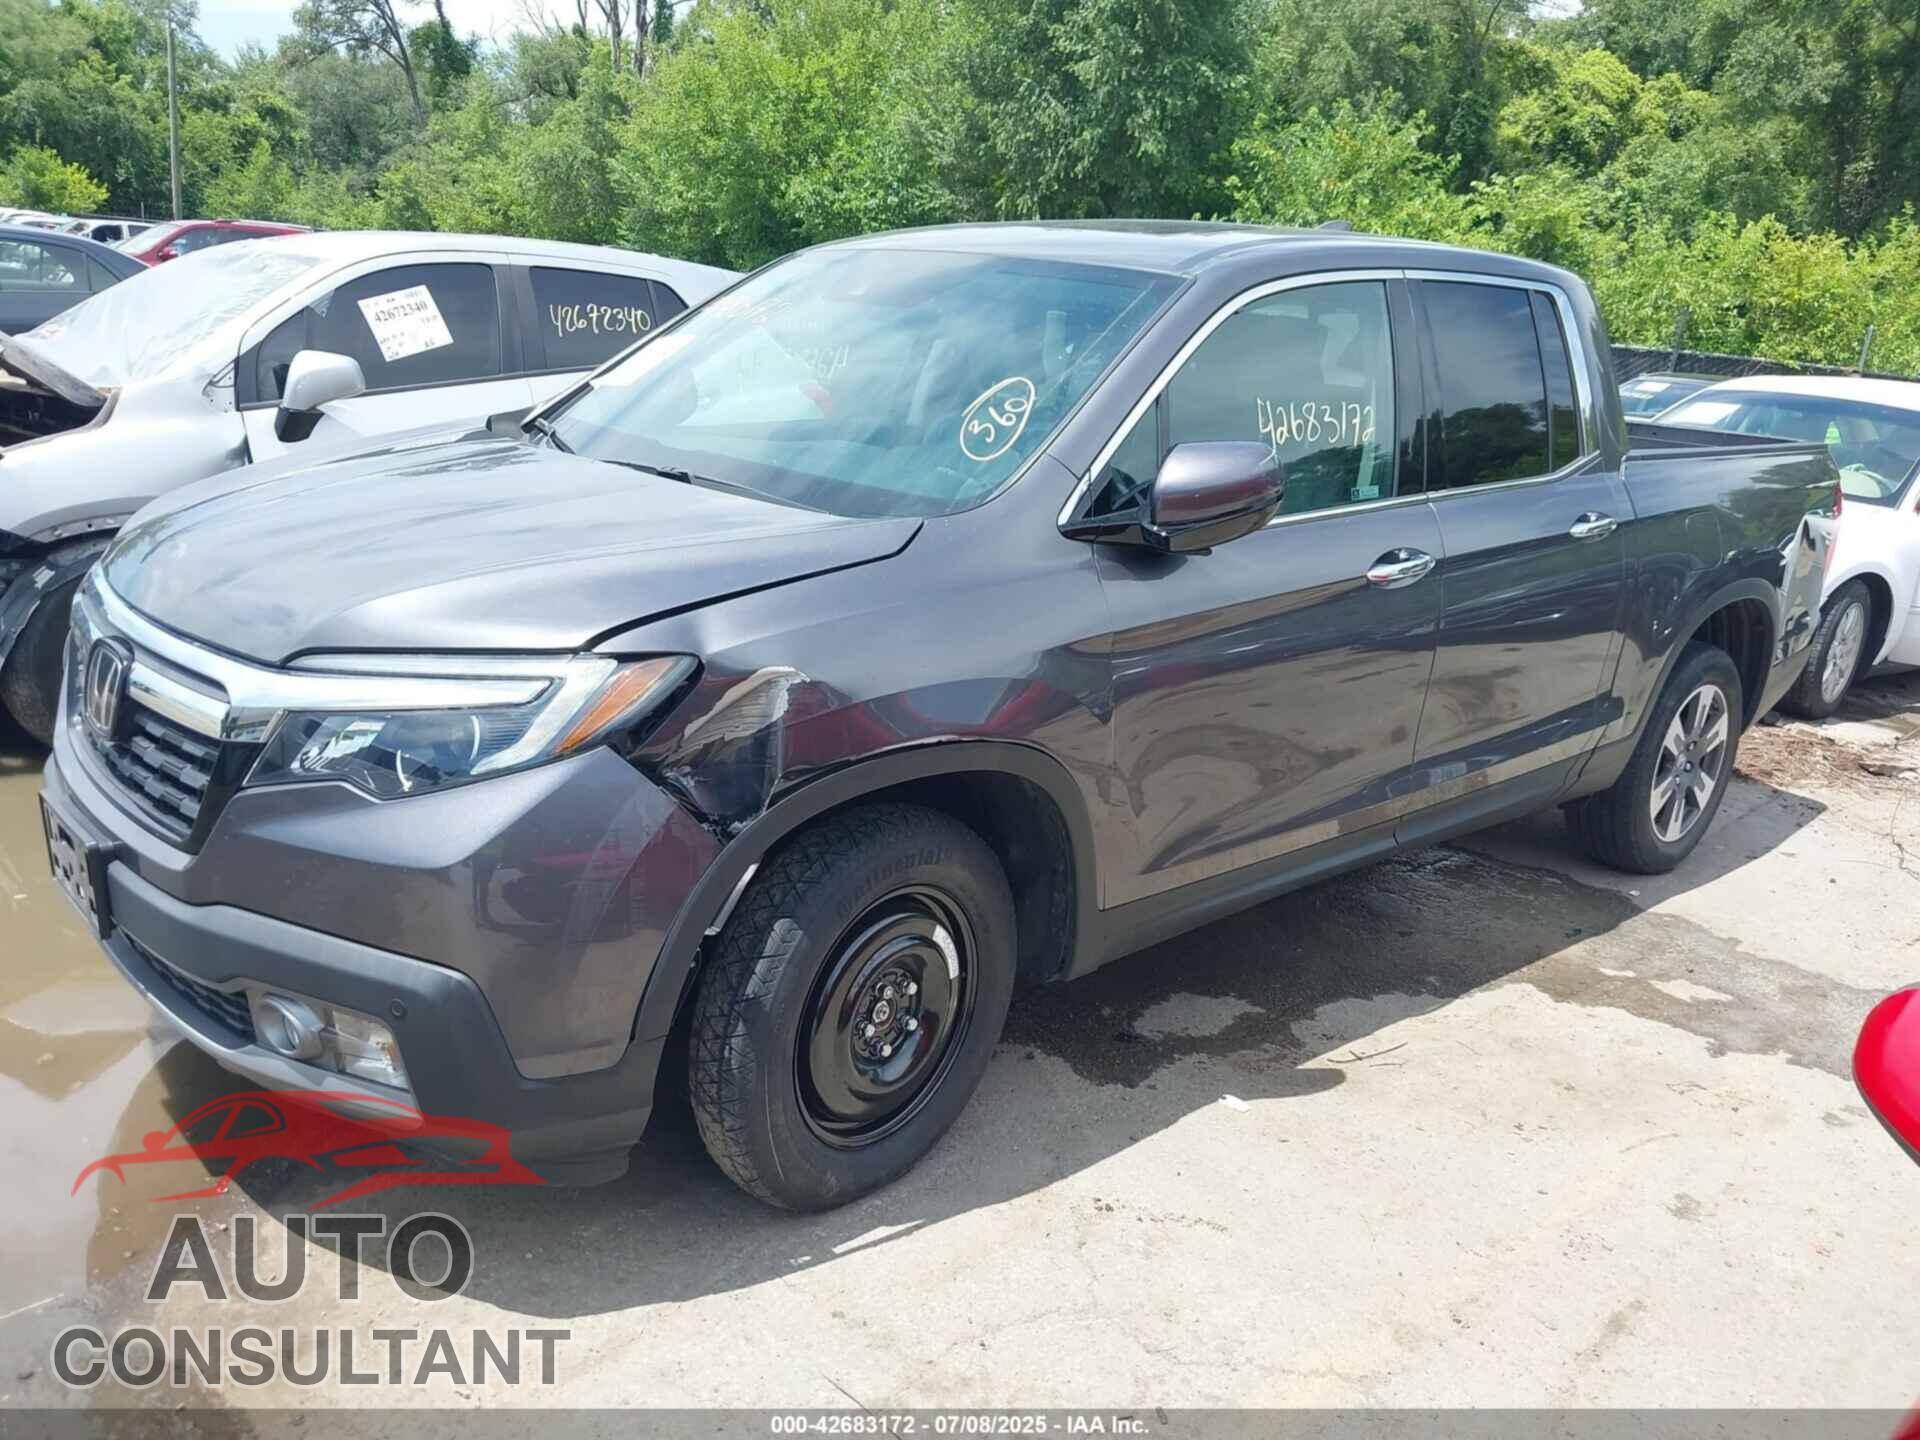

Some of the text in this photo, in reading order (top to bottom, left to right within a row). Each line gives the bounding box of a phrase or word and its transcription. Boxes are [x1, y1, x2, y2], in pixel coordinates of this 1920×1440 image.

[549, 302, 651, 338] 42672340
[967, 396, 1029, 443] 360
[1256, 396, 1377, 449] 42683172
